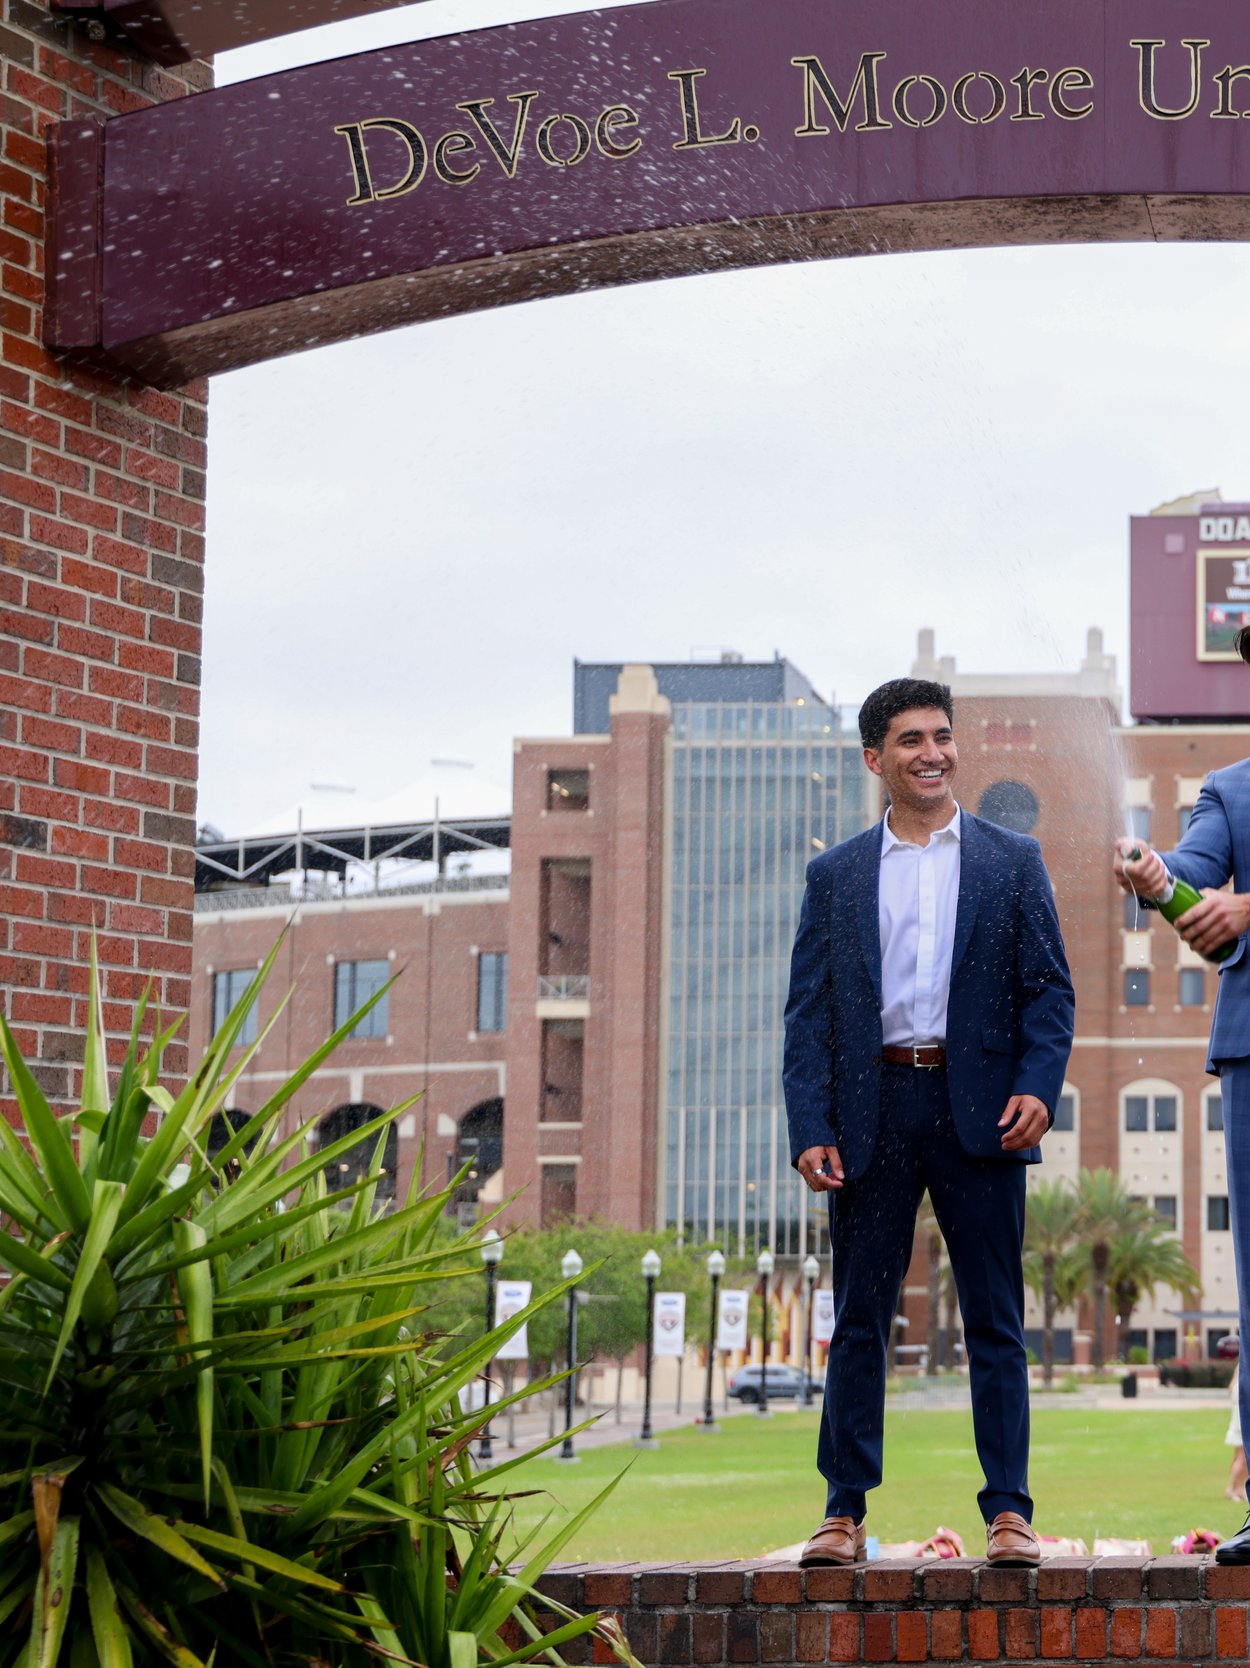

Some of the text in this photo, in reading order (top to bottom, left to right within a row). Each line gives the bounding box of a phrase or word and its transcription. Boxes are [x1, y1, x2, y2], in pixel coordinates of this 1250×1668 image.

[333, 90, 643, 207] DeVoe
[667, 68, 760, 150] L.
[791, 51, 1095, 137] Moore
